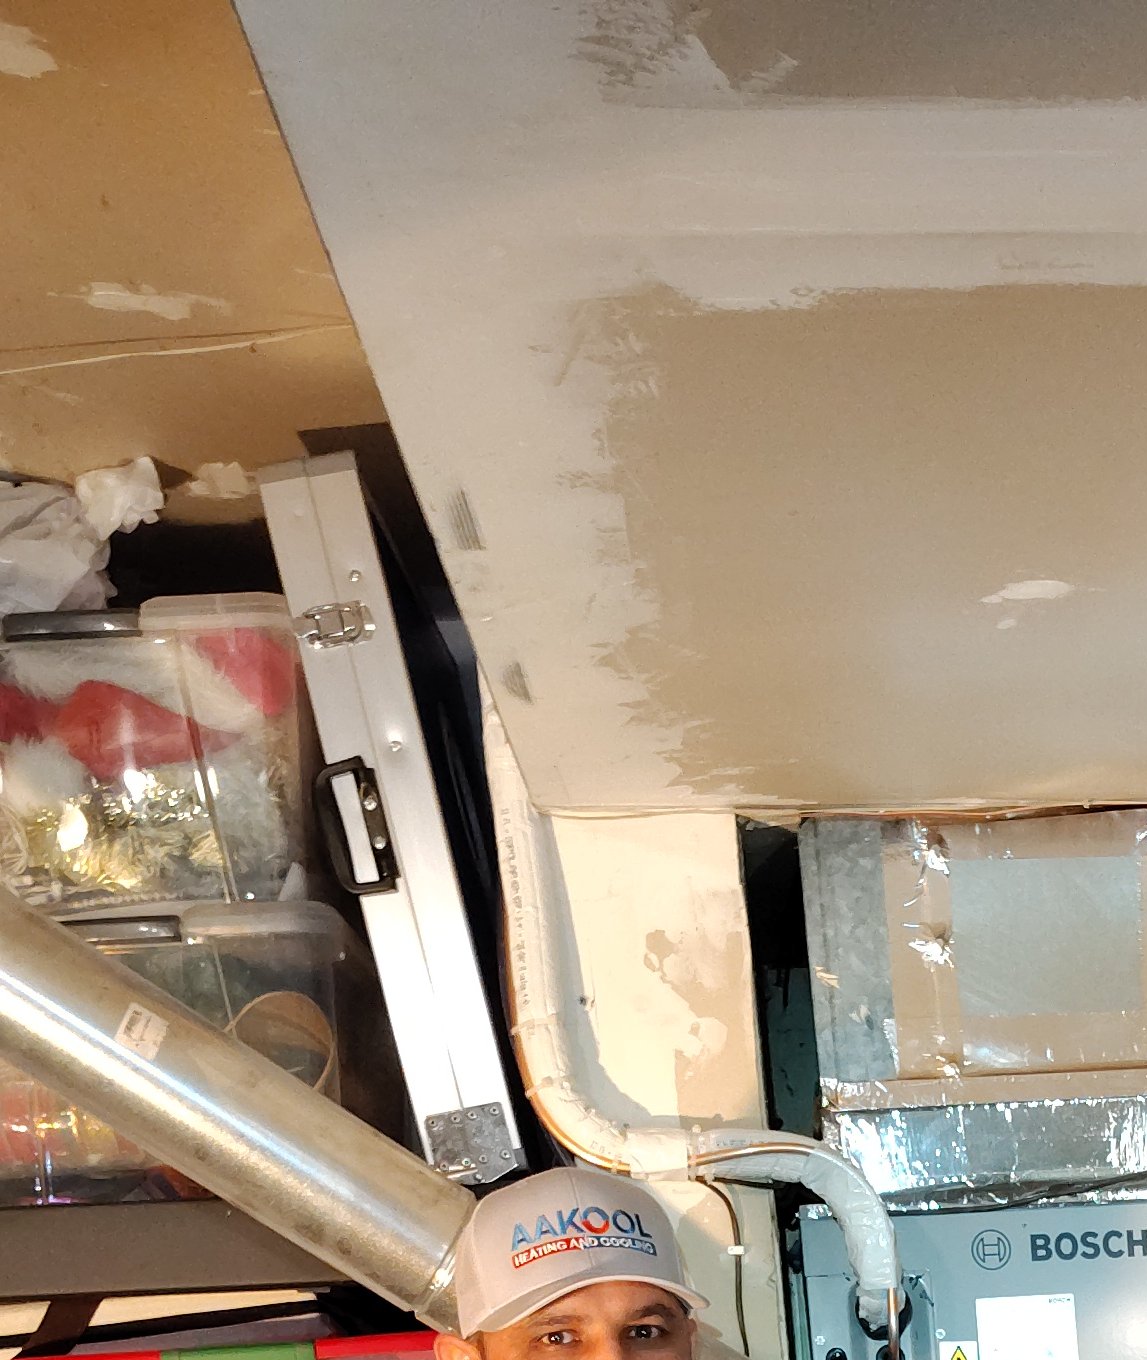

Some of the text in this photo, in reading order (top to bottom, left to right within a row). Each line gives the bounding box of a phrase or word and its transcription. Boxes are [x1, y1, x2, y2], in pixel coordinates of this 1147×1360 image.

[511, 1206, 653, 1250] AAKOOL
[513, 1239, 567, 1267] HEATING
[569, 1236, 598, 1250] AND
